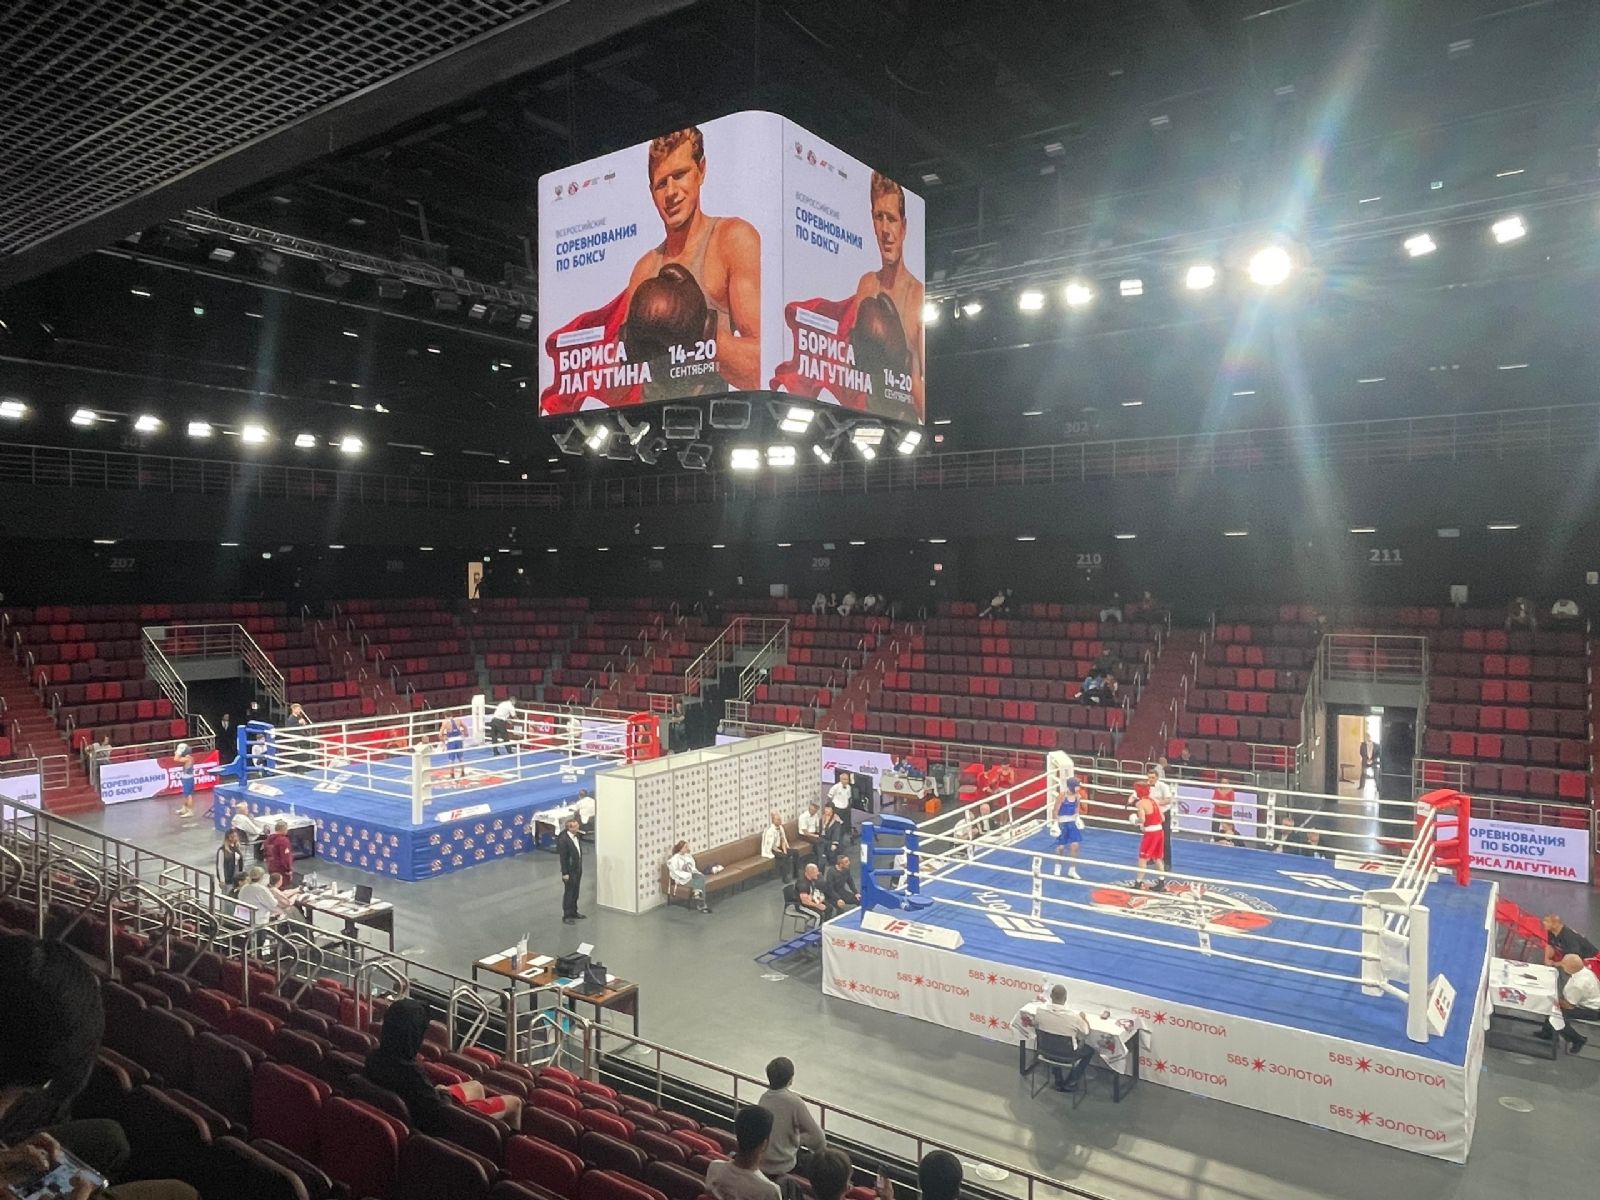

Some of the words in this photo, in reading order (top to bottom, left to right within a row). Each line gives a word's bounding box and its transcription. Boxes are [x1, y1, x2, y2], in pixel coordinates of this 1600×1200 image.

[556, 223, 637, 255] СОРЕВНОВАНИЯ
[795, 206, 863, 250] СОРЕВНОВАНИЯ
[795, 224, 809, 241] ПО
[810, 231, 840, 254] БОКСУ
[556, 258, 570, 272] ПО
[572, 249, 606, 268] БОКСУ
[559, 341, 628, 372] БОРИСА
[668, 339, 717, 365] 14-20
[798, 327, 856, 366] БОРИСА
[558, 361, 652, 395] ЛАГУТИНА
[670, 362, 715, 379] СЕНТЯБРЯ
[797, 354, 873, 395] ЛАГУТИНА
[1076, 552, 1102, 565] 210
[1368, 548, 1402, 562] 211
[101, 773, 166, 790] СОРЕВНОВАНИЯ
[103, 790, 115, 798] ПО
[116, 786, 143, 796] БОКСУ
[1470, 827, 1566, 848] ОРЕВНОВАНИЯ
[1481, 840, 1499, 851] ПО
[1502, 843, 1545, 856] БОКСУ
[1469, 855, 1502, 868] РИСА
[1505, 859, 1577, 878] ЛАГУТИНА
[858, 943, 899, 960] ЗОЛОТОЙ
[969, 969, 985, 981] 585
[859, 984, 900, 1001] ЗОЛОТОЙ
[925, 979, 969, 997] ЗОЛОТОЙ
[970, 1012, 986, 1025] 585
[1132, 1007, 1151, 1020] 585
[1169, 1016, 1227, 1037] ЗОЛОТОЙ
[1170, 1064, 1228, 1087] ЗОЛОТОЙ
[1227, 1053, 1249, 1067] 585
[1269, 1063, 1333, 1087] ЗОЛОТОЙ
[1328, 1052, 1353, 1066] 585
[1374, 1063, 1446, 1089] ЗОЛОТОЙ
[1329, 1104, 1354, 1119] 585
[1375, 1116, 1447, 1142] ЗОЛОТОЙ
